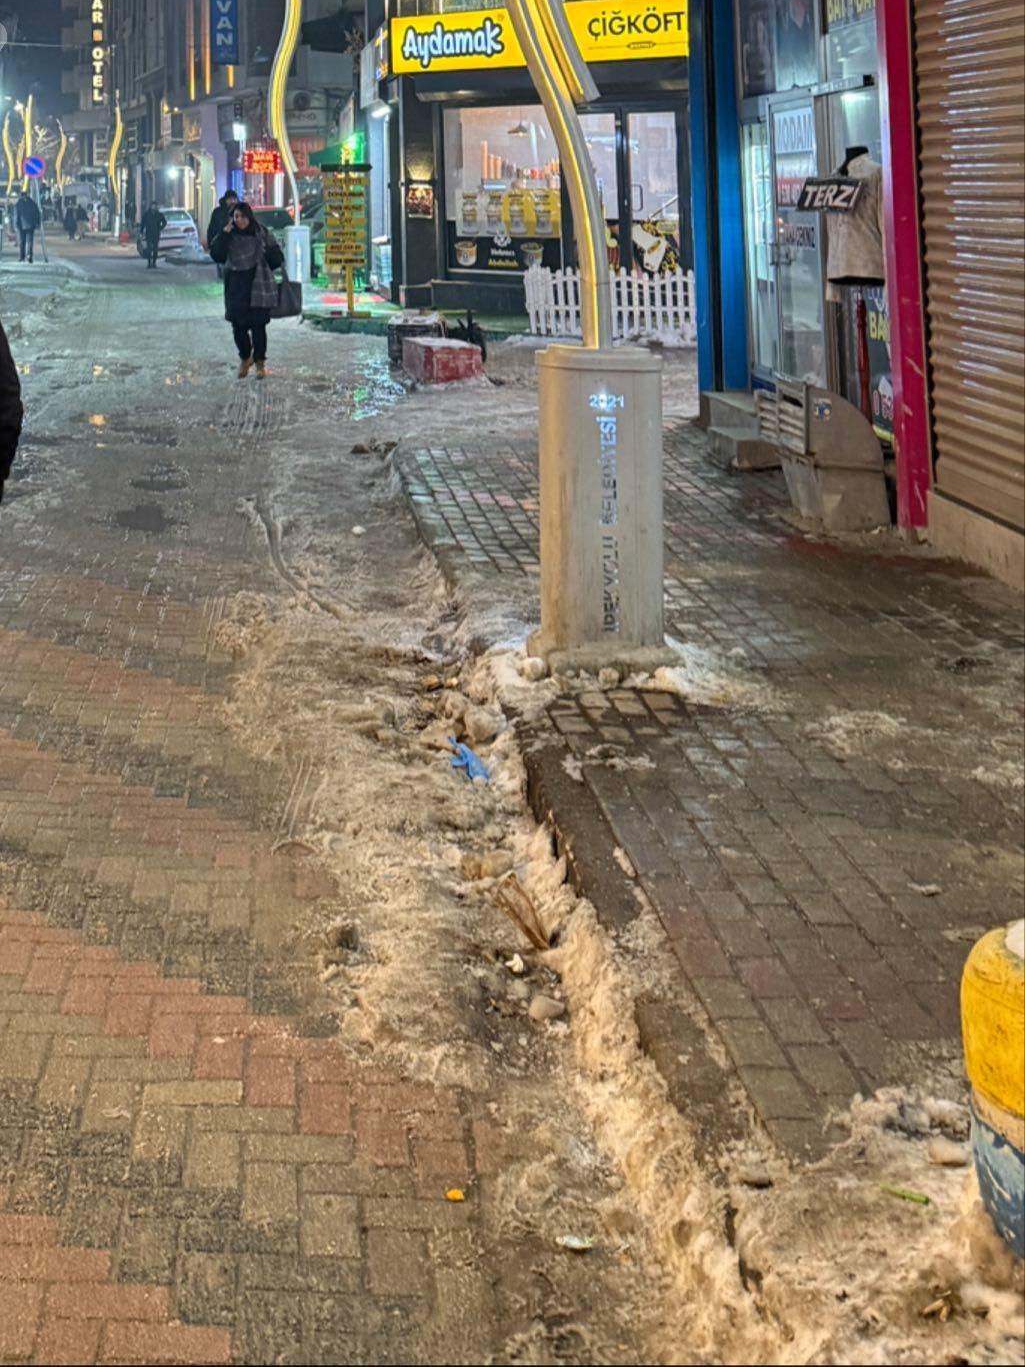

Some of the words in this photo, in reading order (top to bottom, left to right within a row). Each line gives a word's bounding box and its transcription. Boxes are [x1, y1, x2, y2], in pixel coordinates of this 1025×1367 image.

[402, 18, 503, 67] Aydamak
[92, 47, 104, 101] OTEL
[589, 394, 625, 409] 2021
